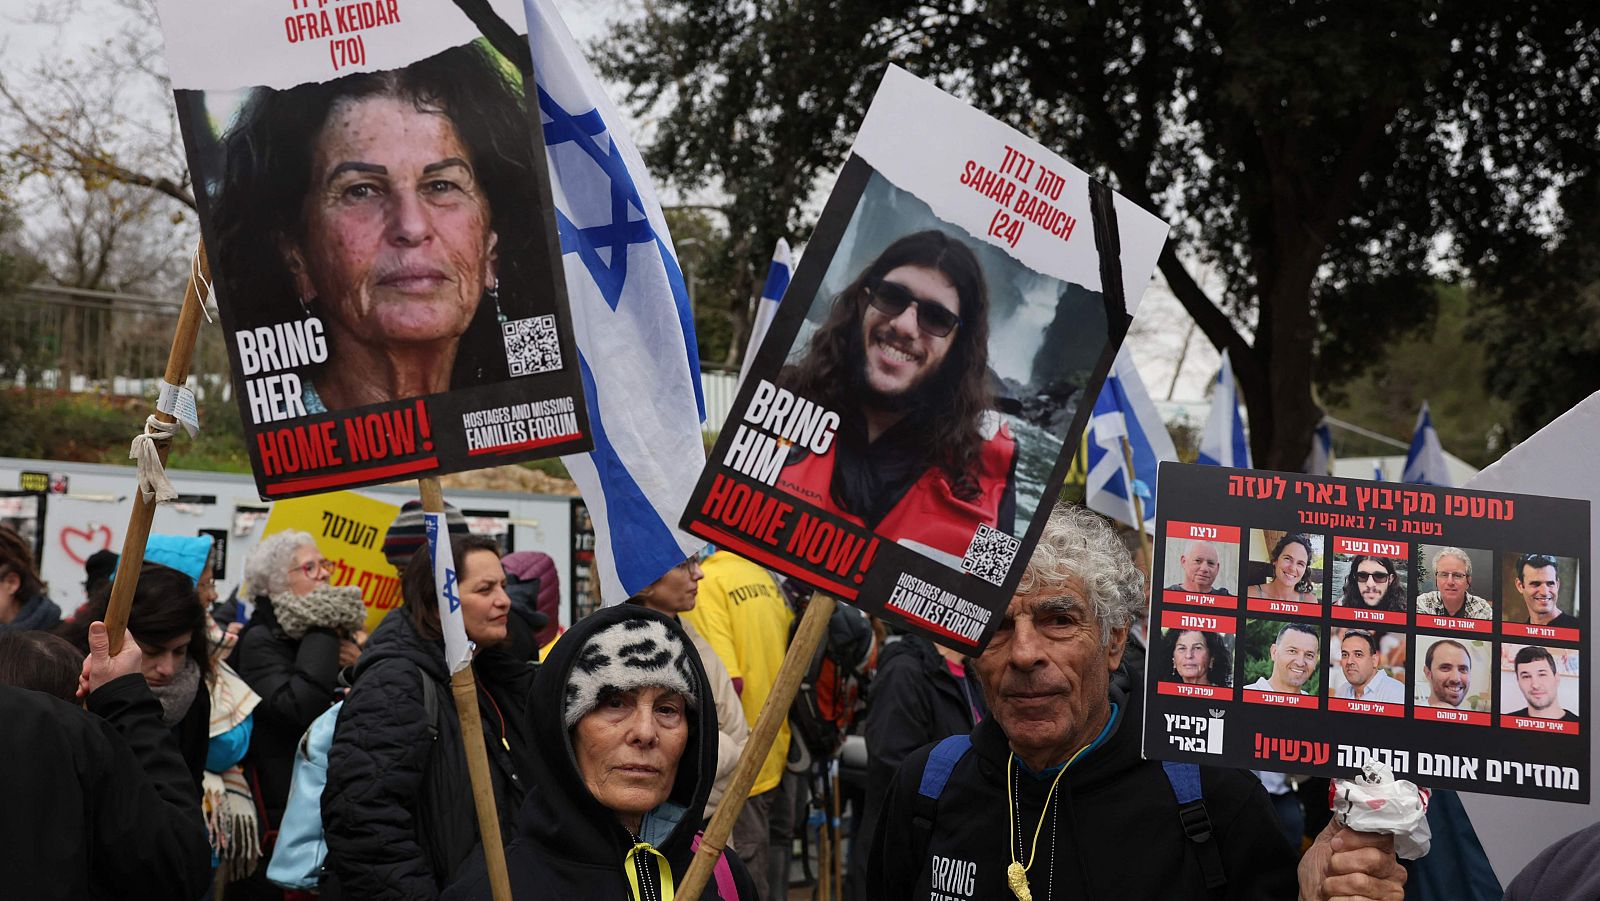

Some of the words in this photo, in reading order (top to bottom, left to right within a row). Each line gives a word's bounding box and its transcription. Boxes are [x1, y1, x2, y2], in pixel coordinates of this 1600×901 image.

[284, 10, 334, 44] OFRA
[334, 0, 401, 34] KEIDAR
[330, 34, 366, 71] (70)
[998, 144, 1036, 185] ברוך
[1035, 164, 1066, 201] סהר
[959, 159, 1017, 206] SAHAR
[1012, 188, 1077, 242] BARUCH
[987, 208, 1025, 249] (24)
[235, 316, 329, 376] BRING
[246, 372, 308, 425] HER
[462, 406, 511, 429] HOSTAGES
[511, 403, 531, 421] AND
[530, 396, 575, 419] MISSING
[743, 378, 841, 455] BRING
[256, 417, 343, 477] HOME
[343, 399, 434, 463] NOW!
[465, 420, 528, 451] FAMILIES
[527, 411, 579, 441] FORUM
[722, 424, 793, 488] HIM
[1228, 475, 1288, 500] לעזה
[1295, 481, 1348, 507] בארי
[1355, 486, 1436, 516] מקיבוץ
[1444, 494, 1515, 521] נחטפו
[700, 473, 795, 546] HOME
[785, 511, 881, 585] NOW!
[1297, 509, 1365, 530] באוקטובר
[1368, 516, 1376, 529] 7
[1401, 519, 1443, 537] בשבת
[322, 510, 379, 550] העוטף
[1190, 526, 1217, 538] נרצח
[1341, 540, 1370, 553] בשבי
[1373, 543, 1400, 556] נרצח
[897, 571, 941, 601] HOSTAGES
[937, 590, 957, 608] AND
[953, 597, 992, 624] MISSING
[1200, 594, 1215, 605] אילן
[1270, 602, 1281, 611] גת
[1281, 602, 1299, 612] כרמל
[887, 585, 945, 625] FAMILIES
[939, 608, 986, 642] FORUM
[1181, 615, 1217, 629] נרצחה
[1353, 610, 1369, 620] ברוך
[1370, 611, 1385, 621] סהר
[1433, 618, 1447, 627] עמי
[1448, 619, 1456, 629] בן
[1457, 620, 1475, 630] אוהד
[1526, 626, 1538, 635] אור
[1540, 628, 1556, 637] דרור
[1177, 686, 1193, 696] קידר
[1194, 687, 1214, 697] עפרה
[1262, 694, 1285, 704] שרעבי
[1286, 696, 1300, 705] יוסי
[1347, 702, 1371, 712] שרעבי
[1371, 704, 1385, 713] אלי
[1436, 710, 1457, 720] שוהם
[1457, 710, 1468, 721] טל
[1163, 713, 1207, 735] קיבוץ
[1515, 718, 1546, 731] סבירסקי
[1547, 721, 1564, 731] איתי
[1169, 735, 1207, 753] בארי
[1254, 732, 1330, 765] עכשיו!
[1417, 752, 1479, 781] אותם
[1485, 758, 1580, 791] מחזירים
[931, 855, 977, 897] BRING
